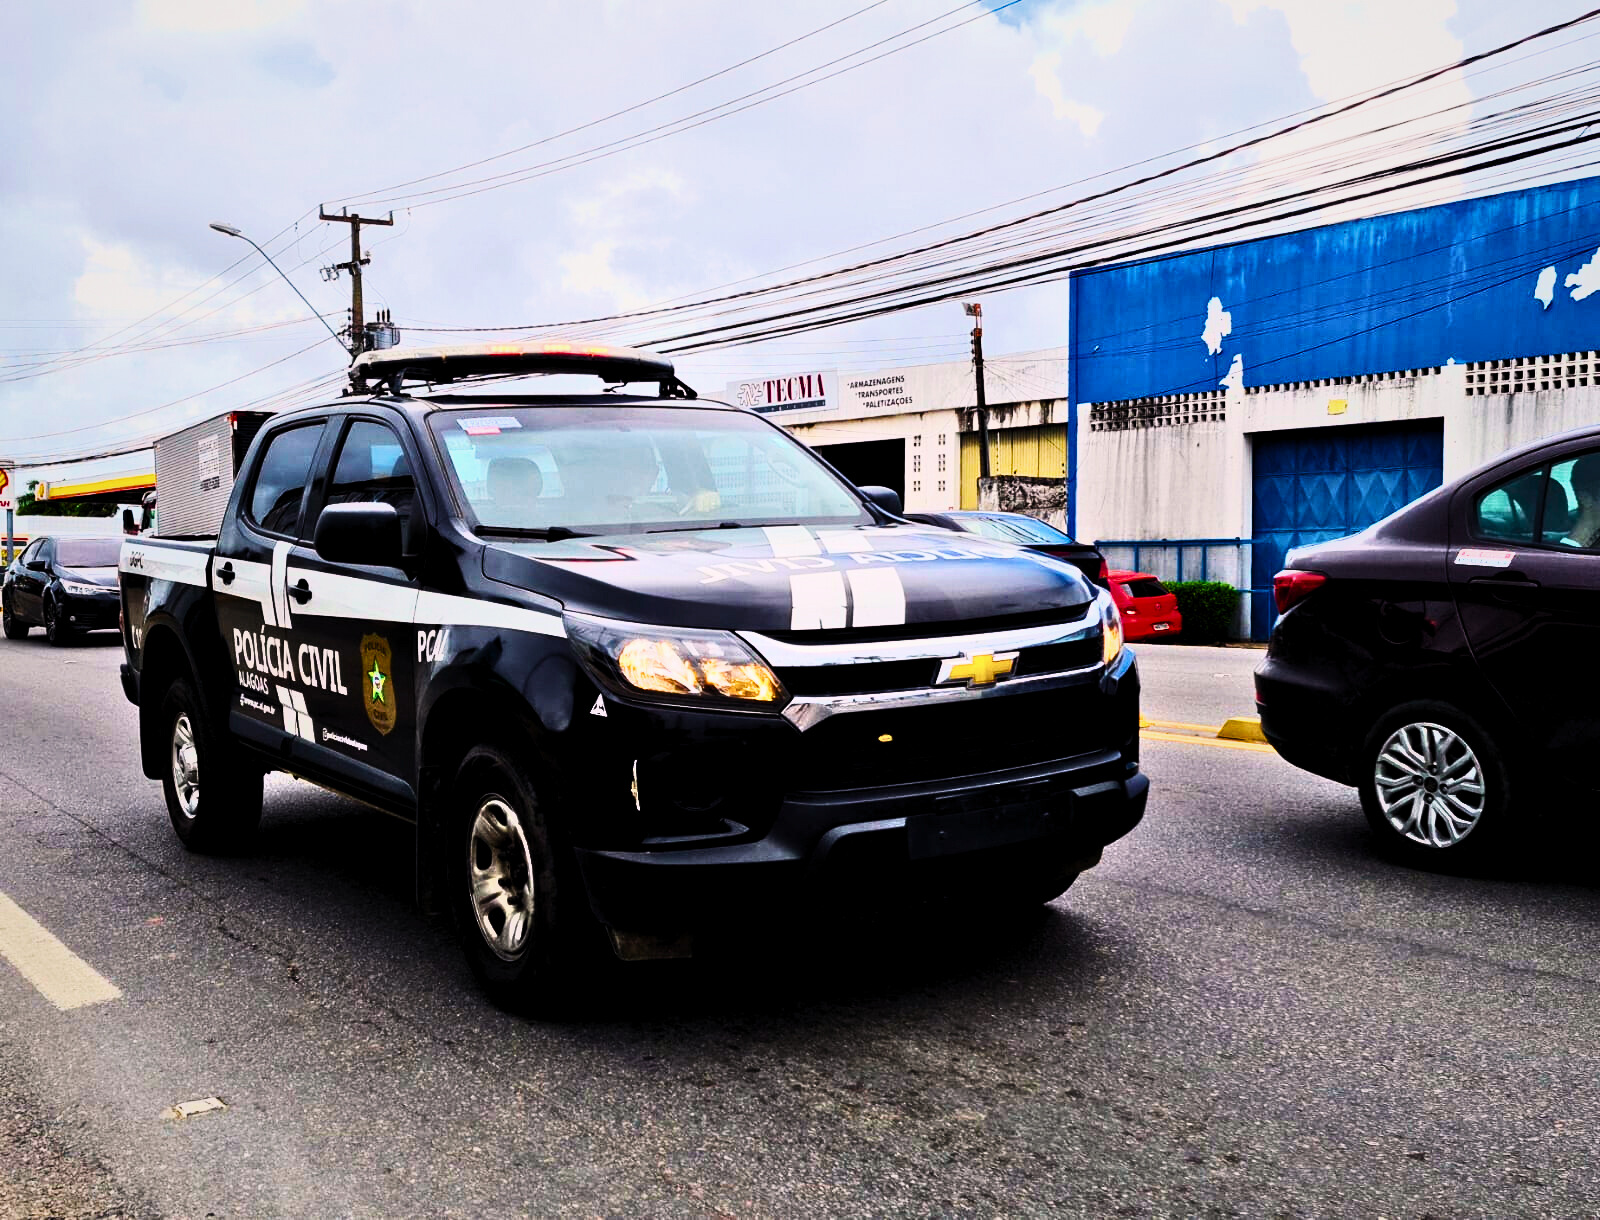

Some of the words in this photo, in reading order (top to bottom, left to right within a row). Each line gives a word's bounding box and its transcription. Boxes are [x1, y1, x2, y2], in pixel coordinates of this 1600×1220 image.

[763, 373, 825, 403] TECMA
[850, 375, 905, 389] ARMAZENAGENS
[858, 387, 903, 398] TRANSPORTES
[233, 624, 296, 682] POLÍCIA
[298, 643, 348, 696] CIVIL
[238, 669, 269, 695] ALAGOAS
